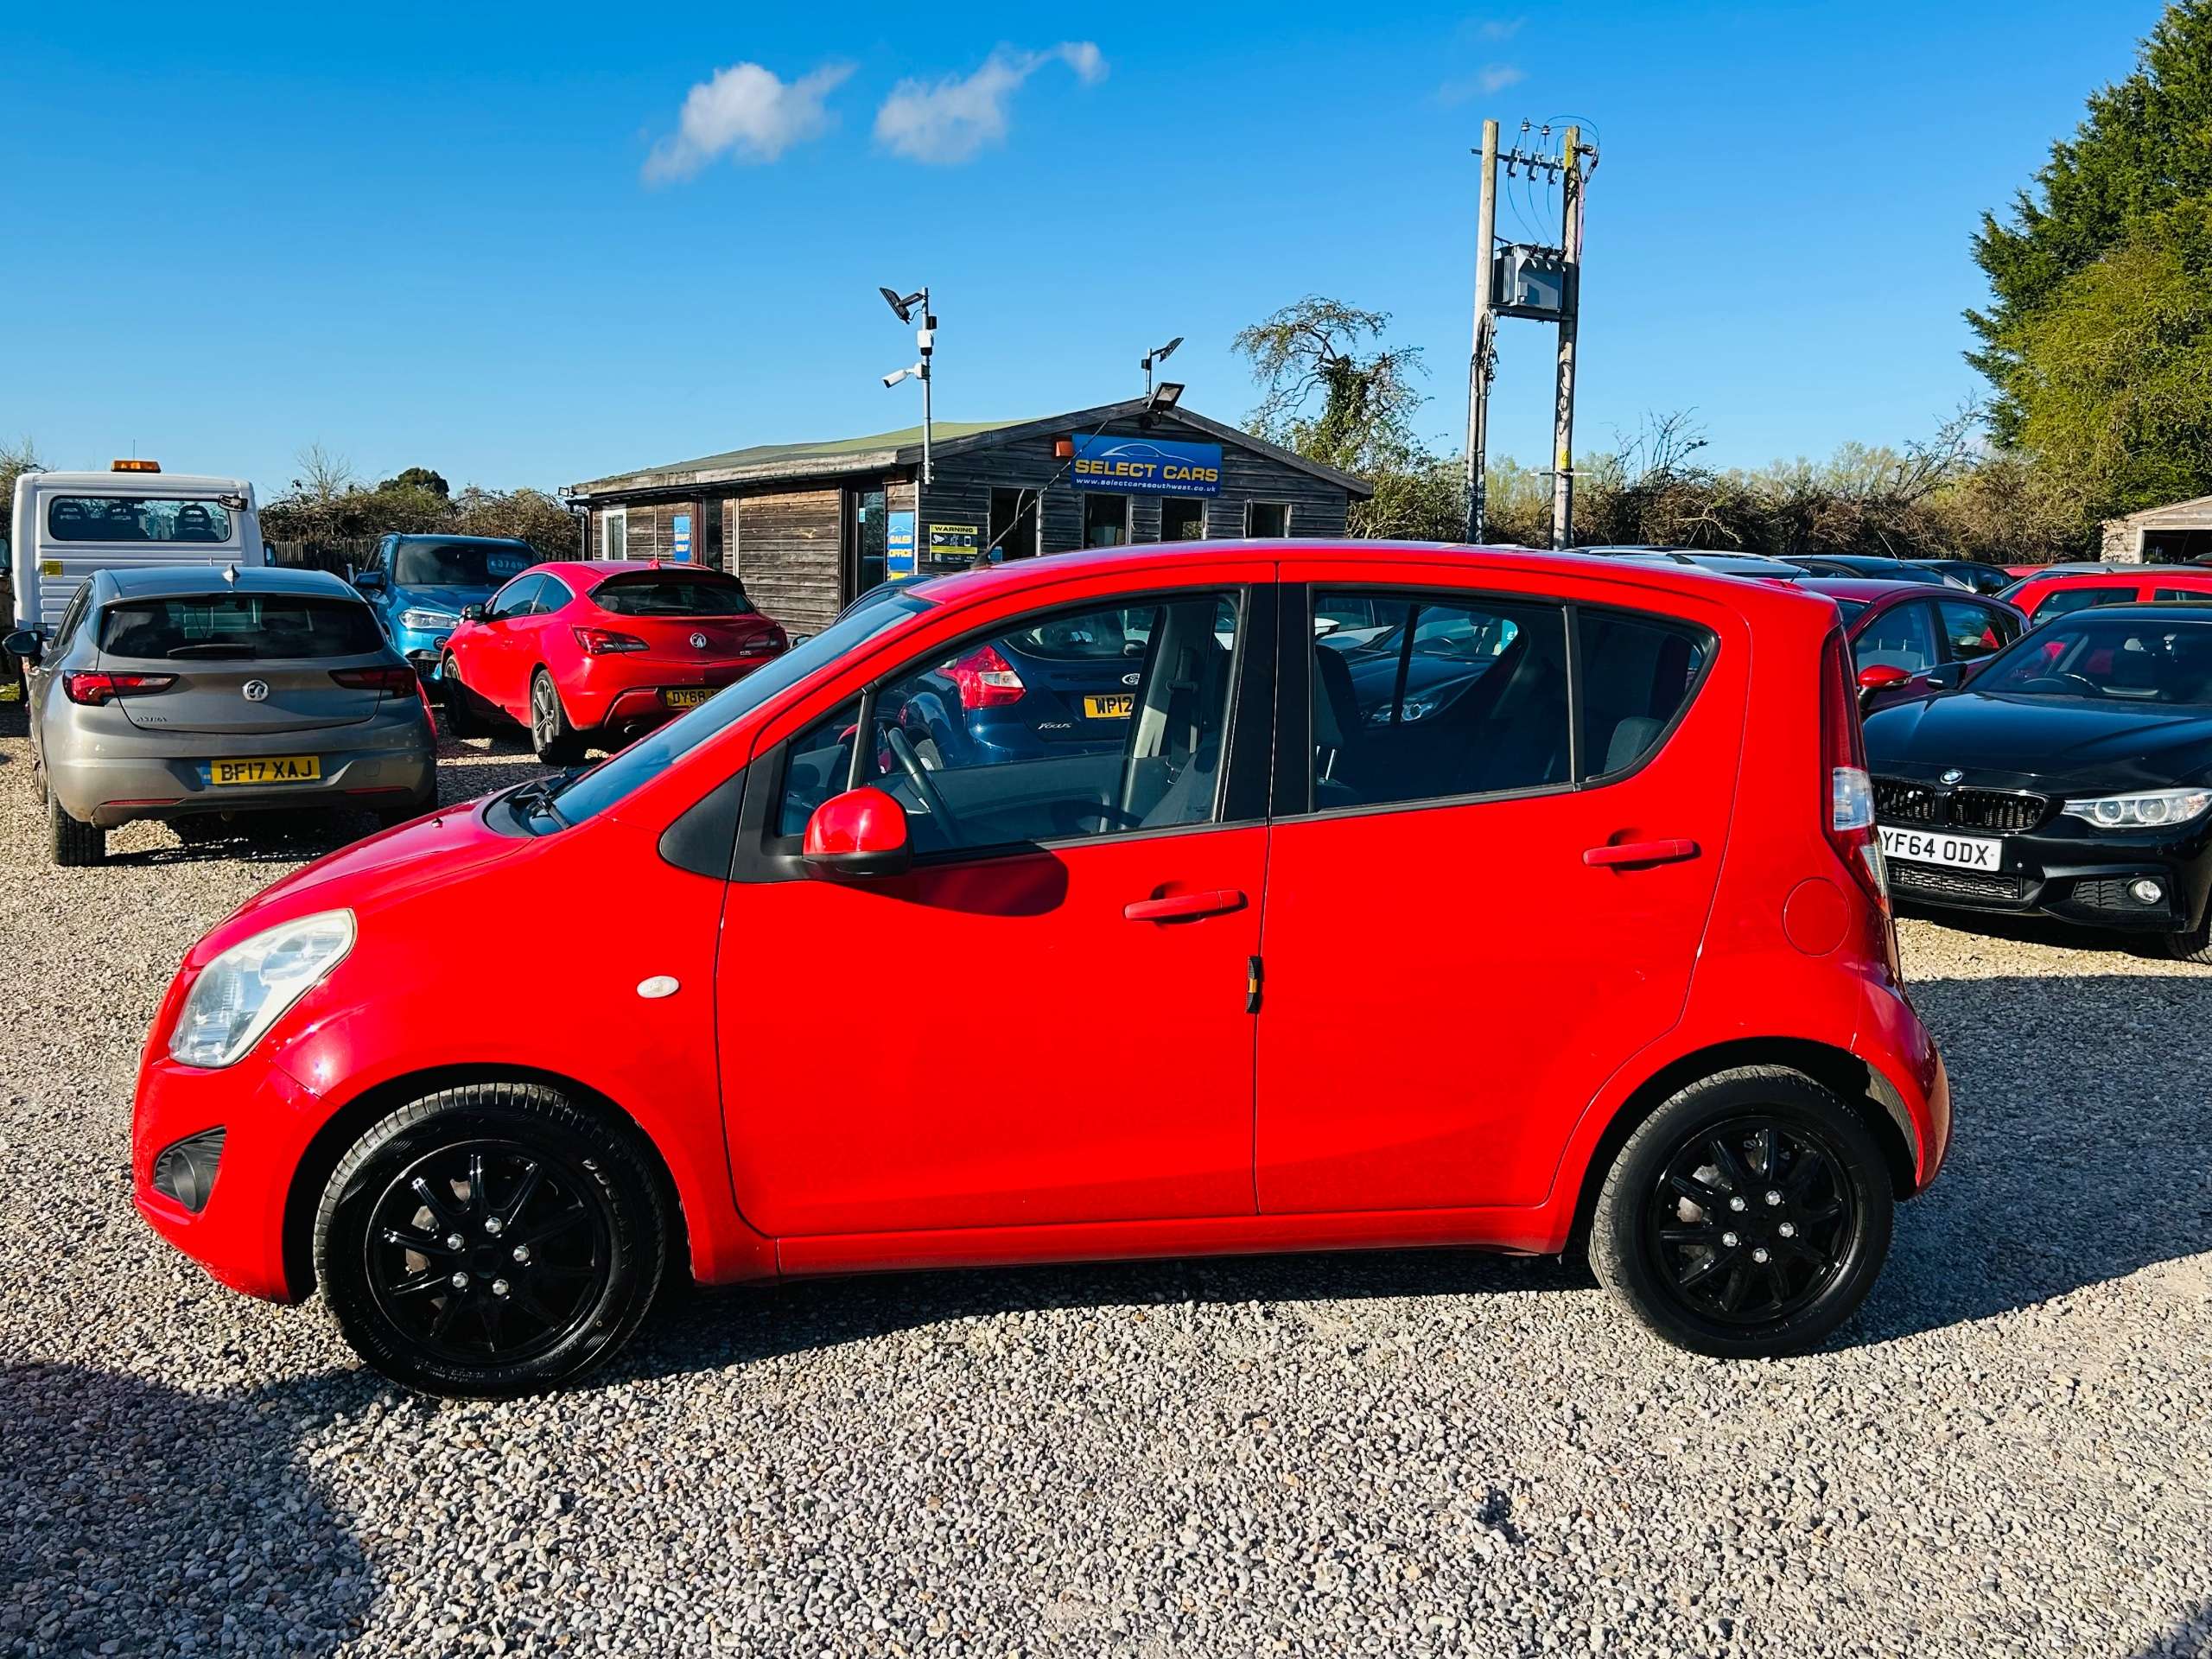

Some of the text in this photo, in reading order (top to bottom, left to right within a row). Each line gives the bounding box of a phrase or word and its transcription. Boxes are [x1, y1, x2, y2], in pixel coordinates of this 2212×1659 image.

[1074, 459, 1218, 482] SELECT CARS
[1076, 478, 1217, 493] www.selectcarssouthwest.co.uk
[889, 535, 912, 544] SALES
[889, 549, 912, 558] OFFICE
[672, 690, 706, 703] DY68
[1095, 695, 1133, 715] WP12
[220, 760, 312, 782] BF17 XAJ
[1882, 830, 1989, 866] YF64 ODX
